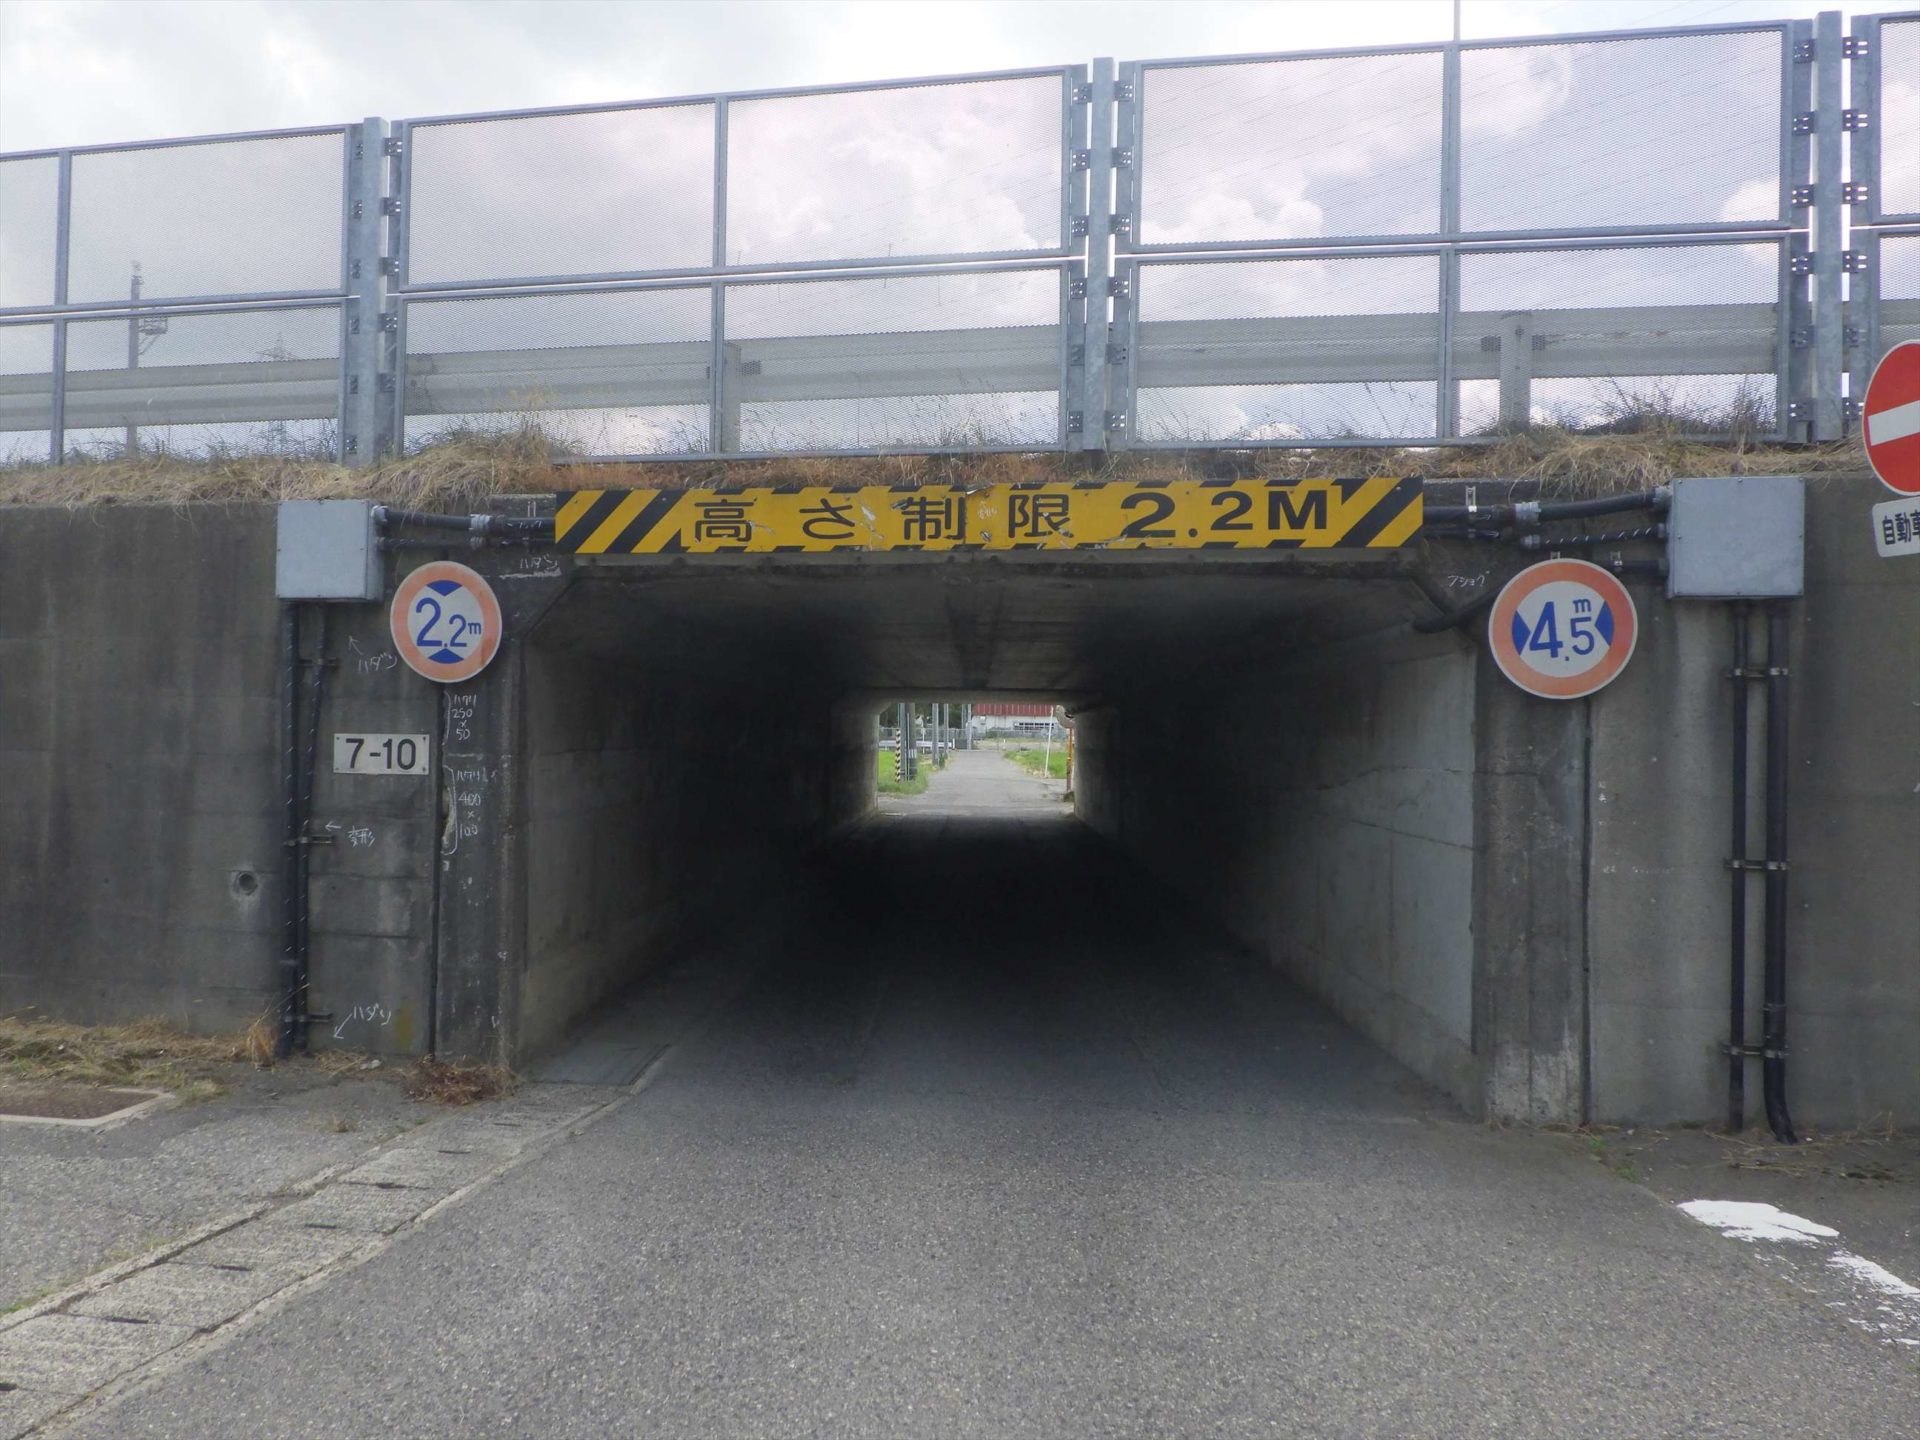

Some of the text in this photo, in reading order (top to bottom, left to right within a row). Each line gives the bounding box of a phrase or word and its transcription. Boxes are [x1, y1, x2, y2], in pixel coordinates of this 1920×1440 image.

[694, 490, 1328, 542] 高さ制限 2.2M
[416, 597, 482, 647] 2.2m
[345, 738, 417, 770] 7-10
